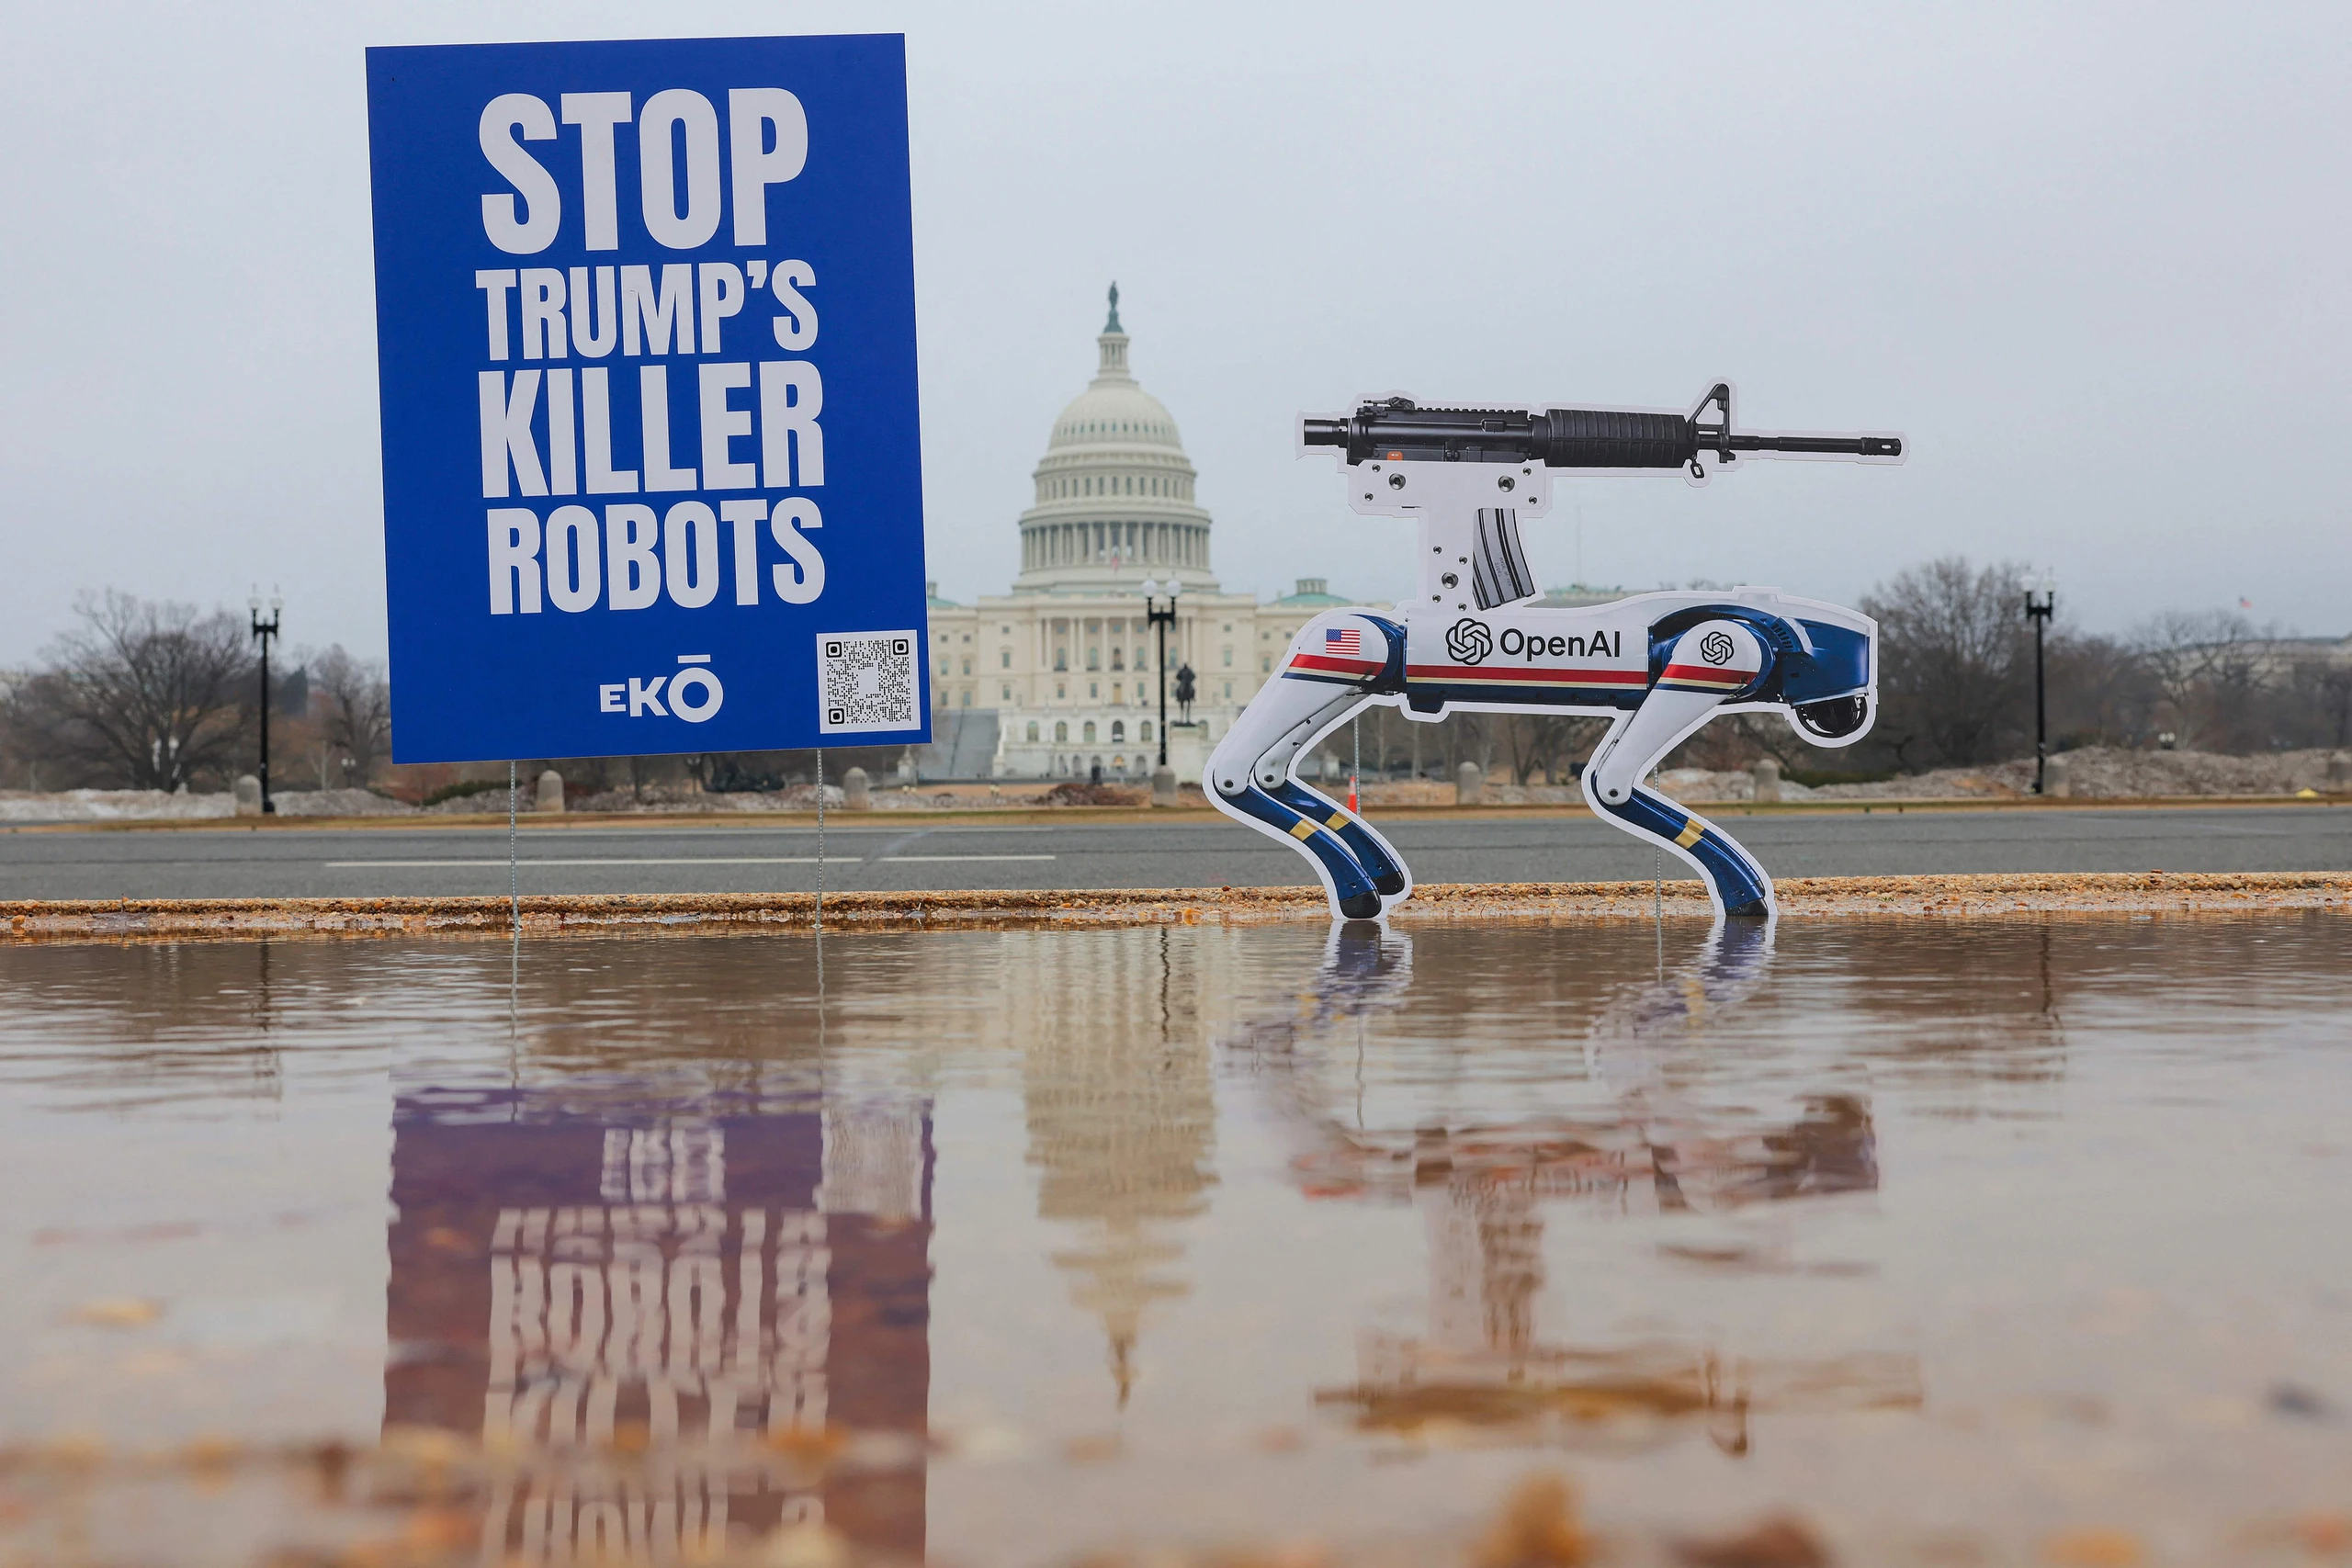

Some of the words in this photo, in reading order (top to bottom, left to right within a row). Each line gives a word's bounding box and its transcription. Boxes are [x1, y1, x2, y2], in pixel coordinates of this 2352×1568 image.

[478, 88, 808, 254] STOP
[475, 259, 819, 361] TRUMP’S
[478, 360, 825, 499] KILLER
[486, 496, 826, 615] ROBOTS
[599, 654, 724, 723] EKŌ
[1500, 628, 1621, 662] OpenAI
